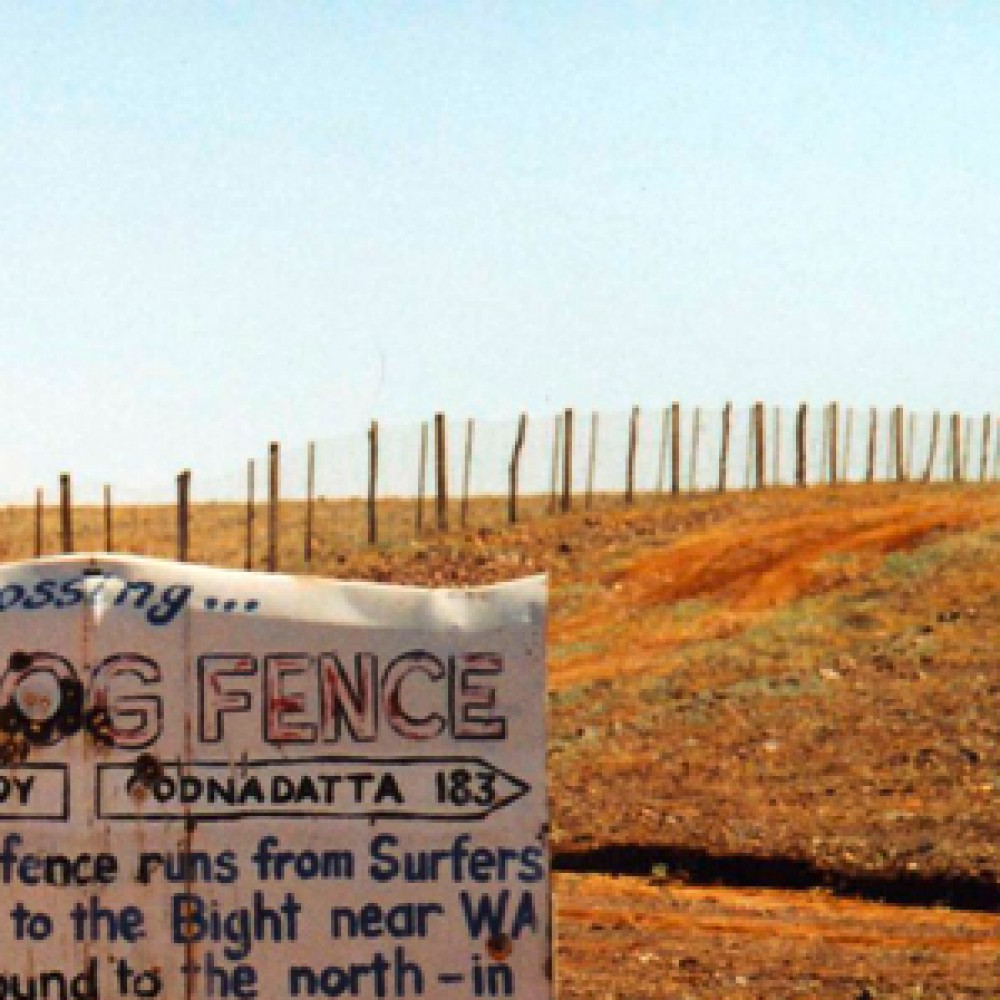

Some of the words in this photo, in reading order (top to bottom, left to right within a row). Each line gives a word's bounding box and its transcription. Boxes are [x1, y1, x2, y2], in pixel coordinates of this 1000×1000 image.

[198, 650, 507, 744] FENCE
[435, 770, 496, 807] 183
[136, 848, 238, 884] runs
[252, 836, 354, 882] from
[369, 834, 544, 884] Surfers
[11, 903, 54, 941] to
[69, 896, 146, 943] the
[171, 890, 301, 961] Bight
[331, 902, 445, 939] near
[116, 957, 162, 1000] to
